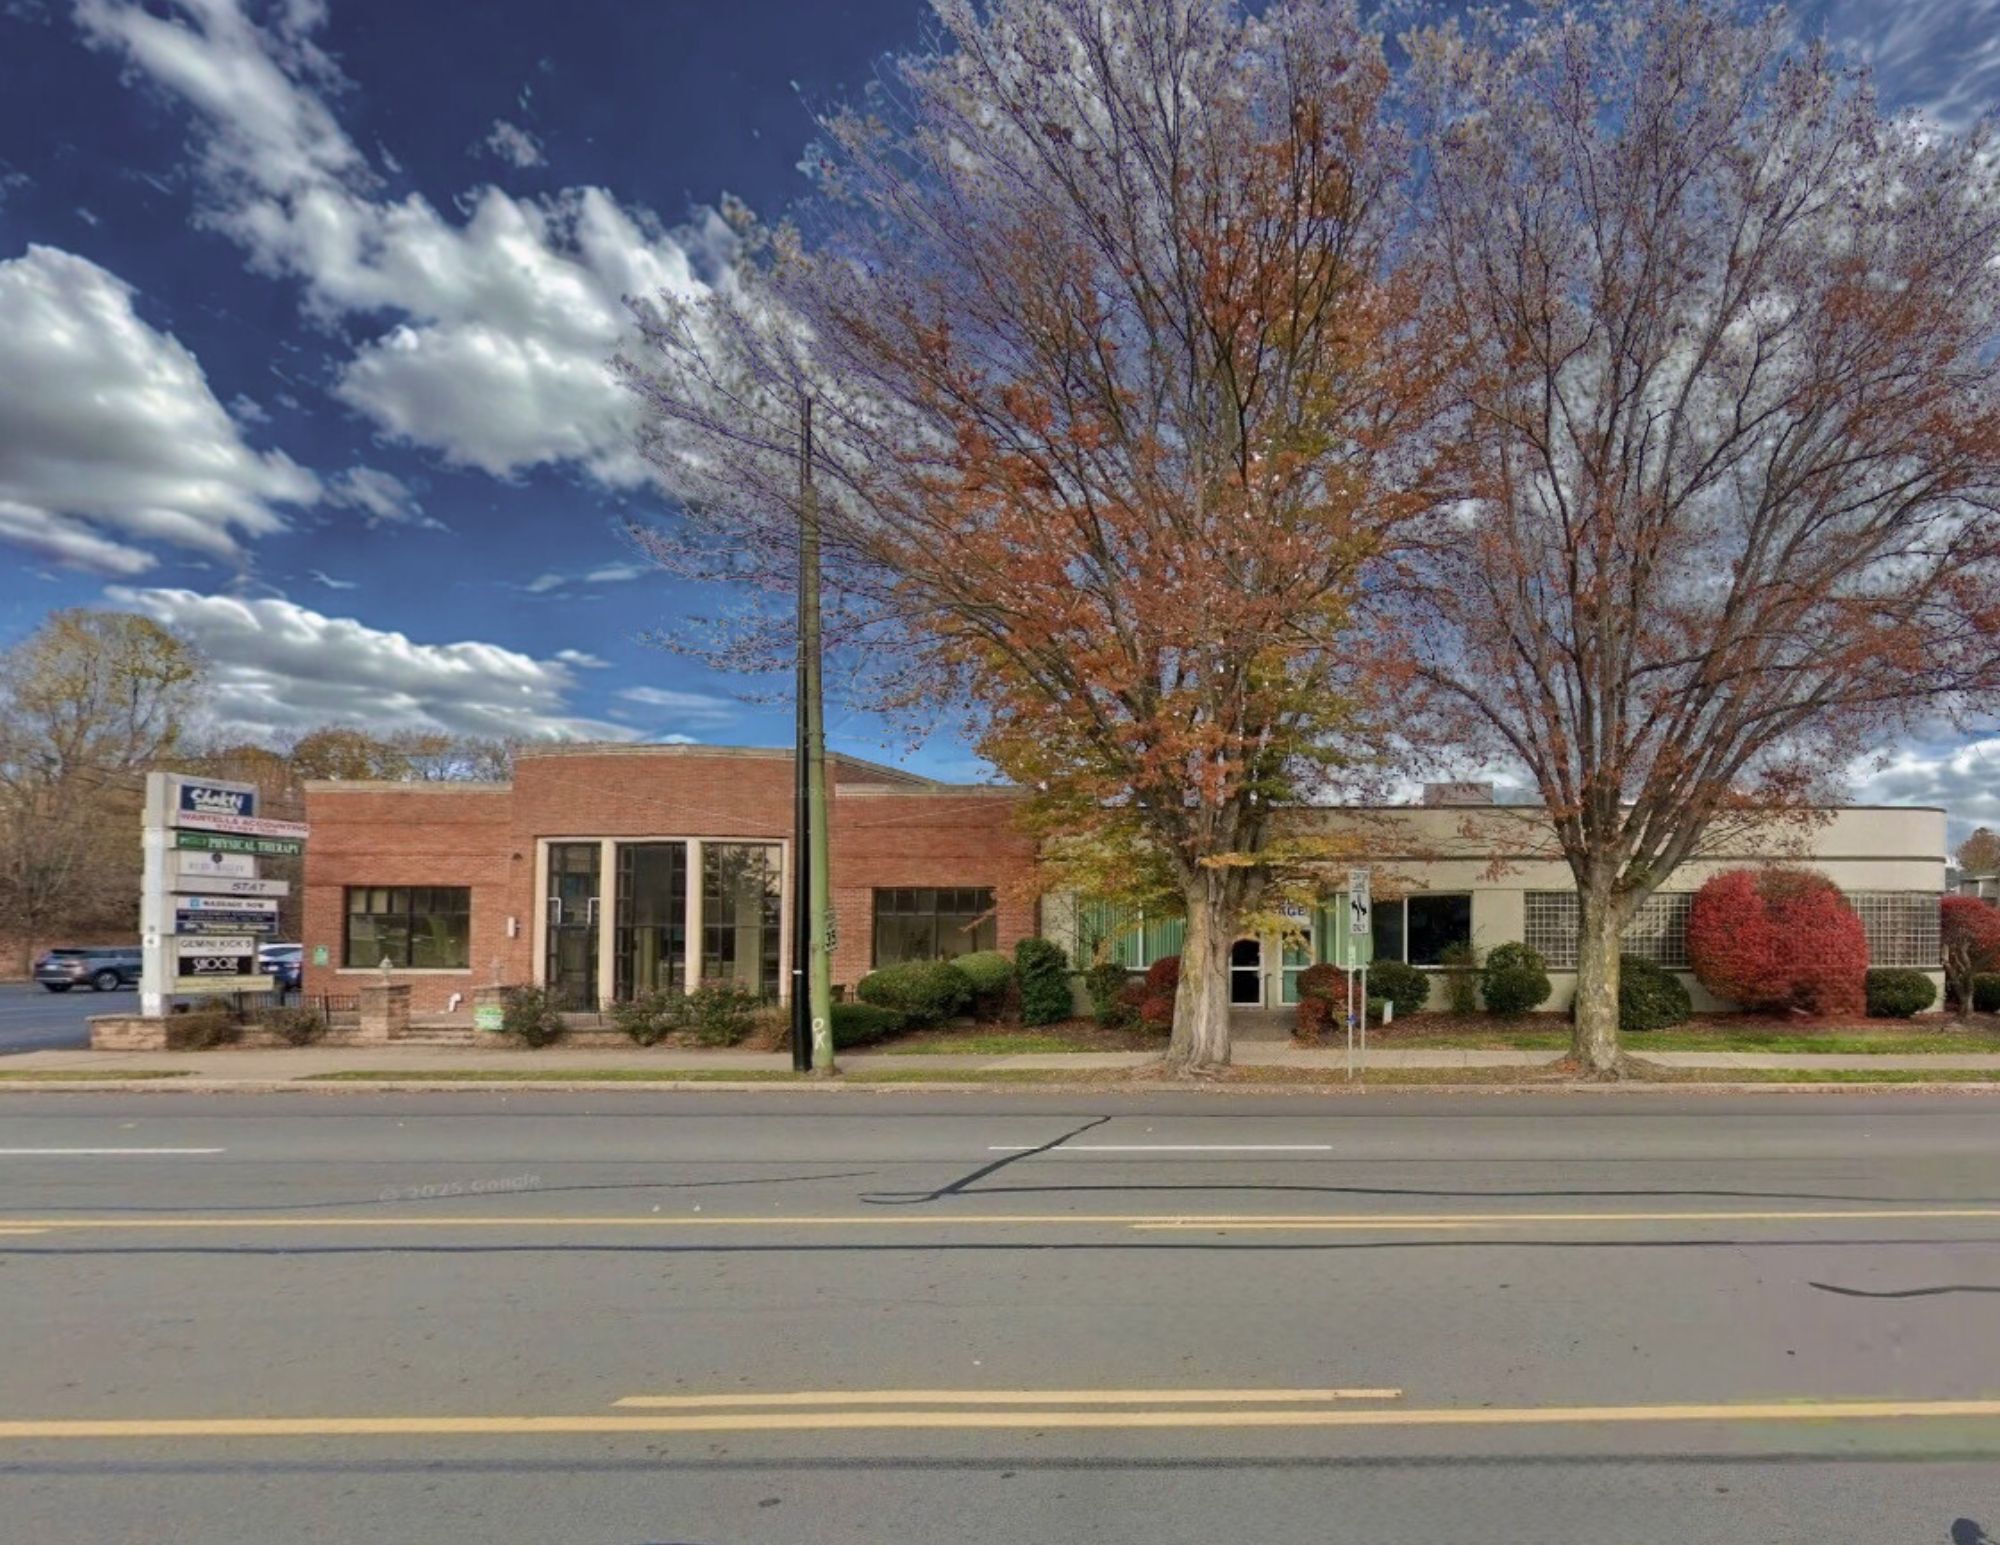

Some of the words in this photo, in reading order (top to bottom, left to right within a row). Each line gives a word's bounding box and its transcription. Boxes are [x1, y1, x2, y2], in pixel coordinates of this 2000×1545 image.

[208, 837, 256, 851] PHYSICAL
[257, 841, 300, 854] THERAPY
[231, 882, 267, 891] STAT
